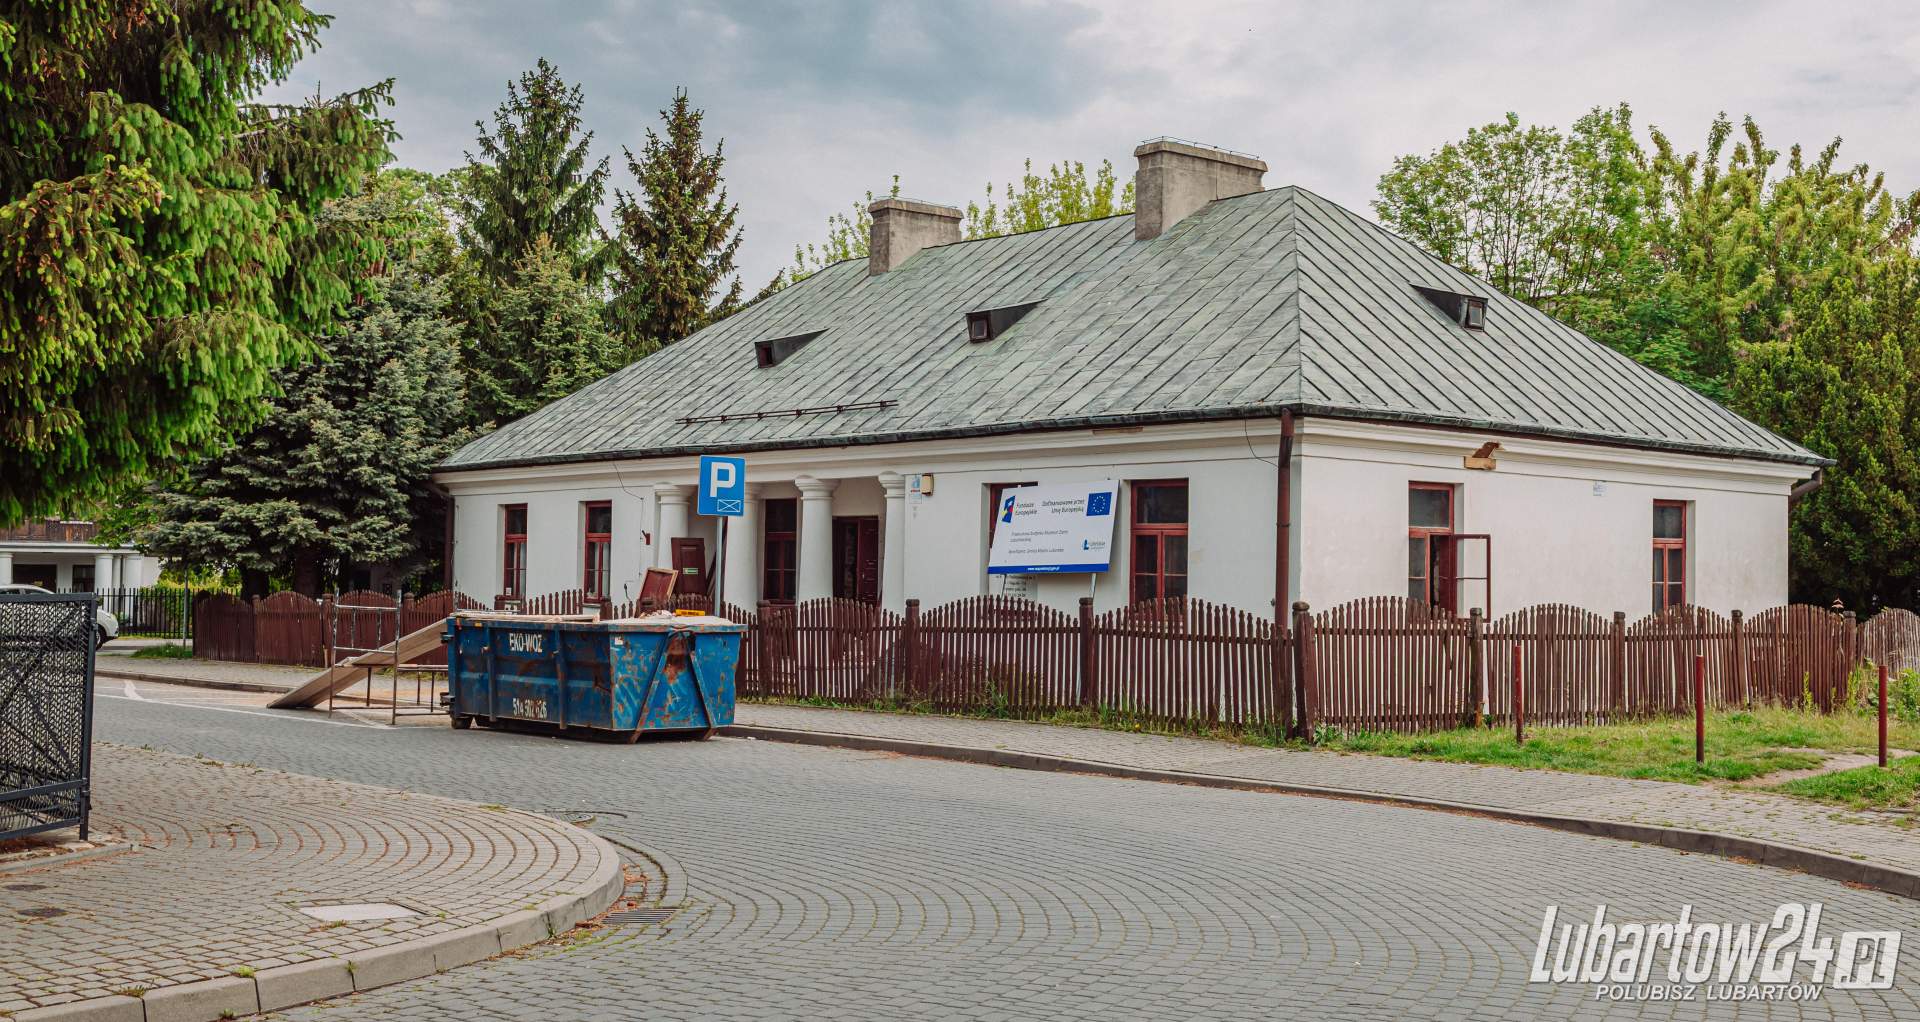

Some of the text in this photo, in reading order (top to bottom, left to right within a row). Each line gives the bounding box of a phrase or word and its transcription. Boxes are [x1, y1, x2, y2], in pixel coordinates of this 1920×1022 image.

[709, 461, 736, 498] P
[509, 632, 543, 653] EKO-WOZ
[512, 697, 524, 717] 514
